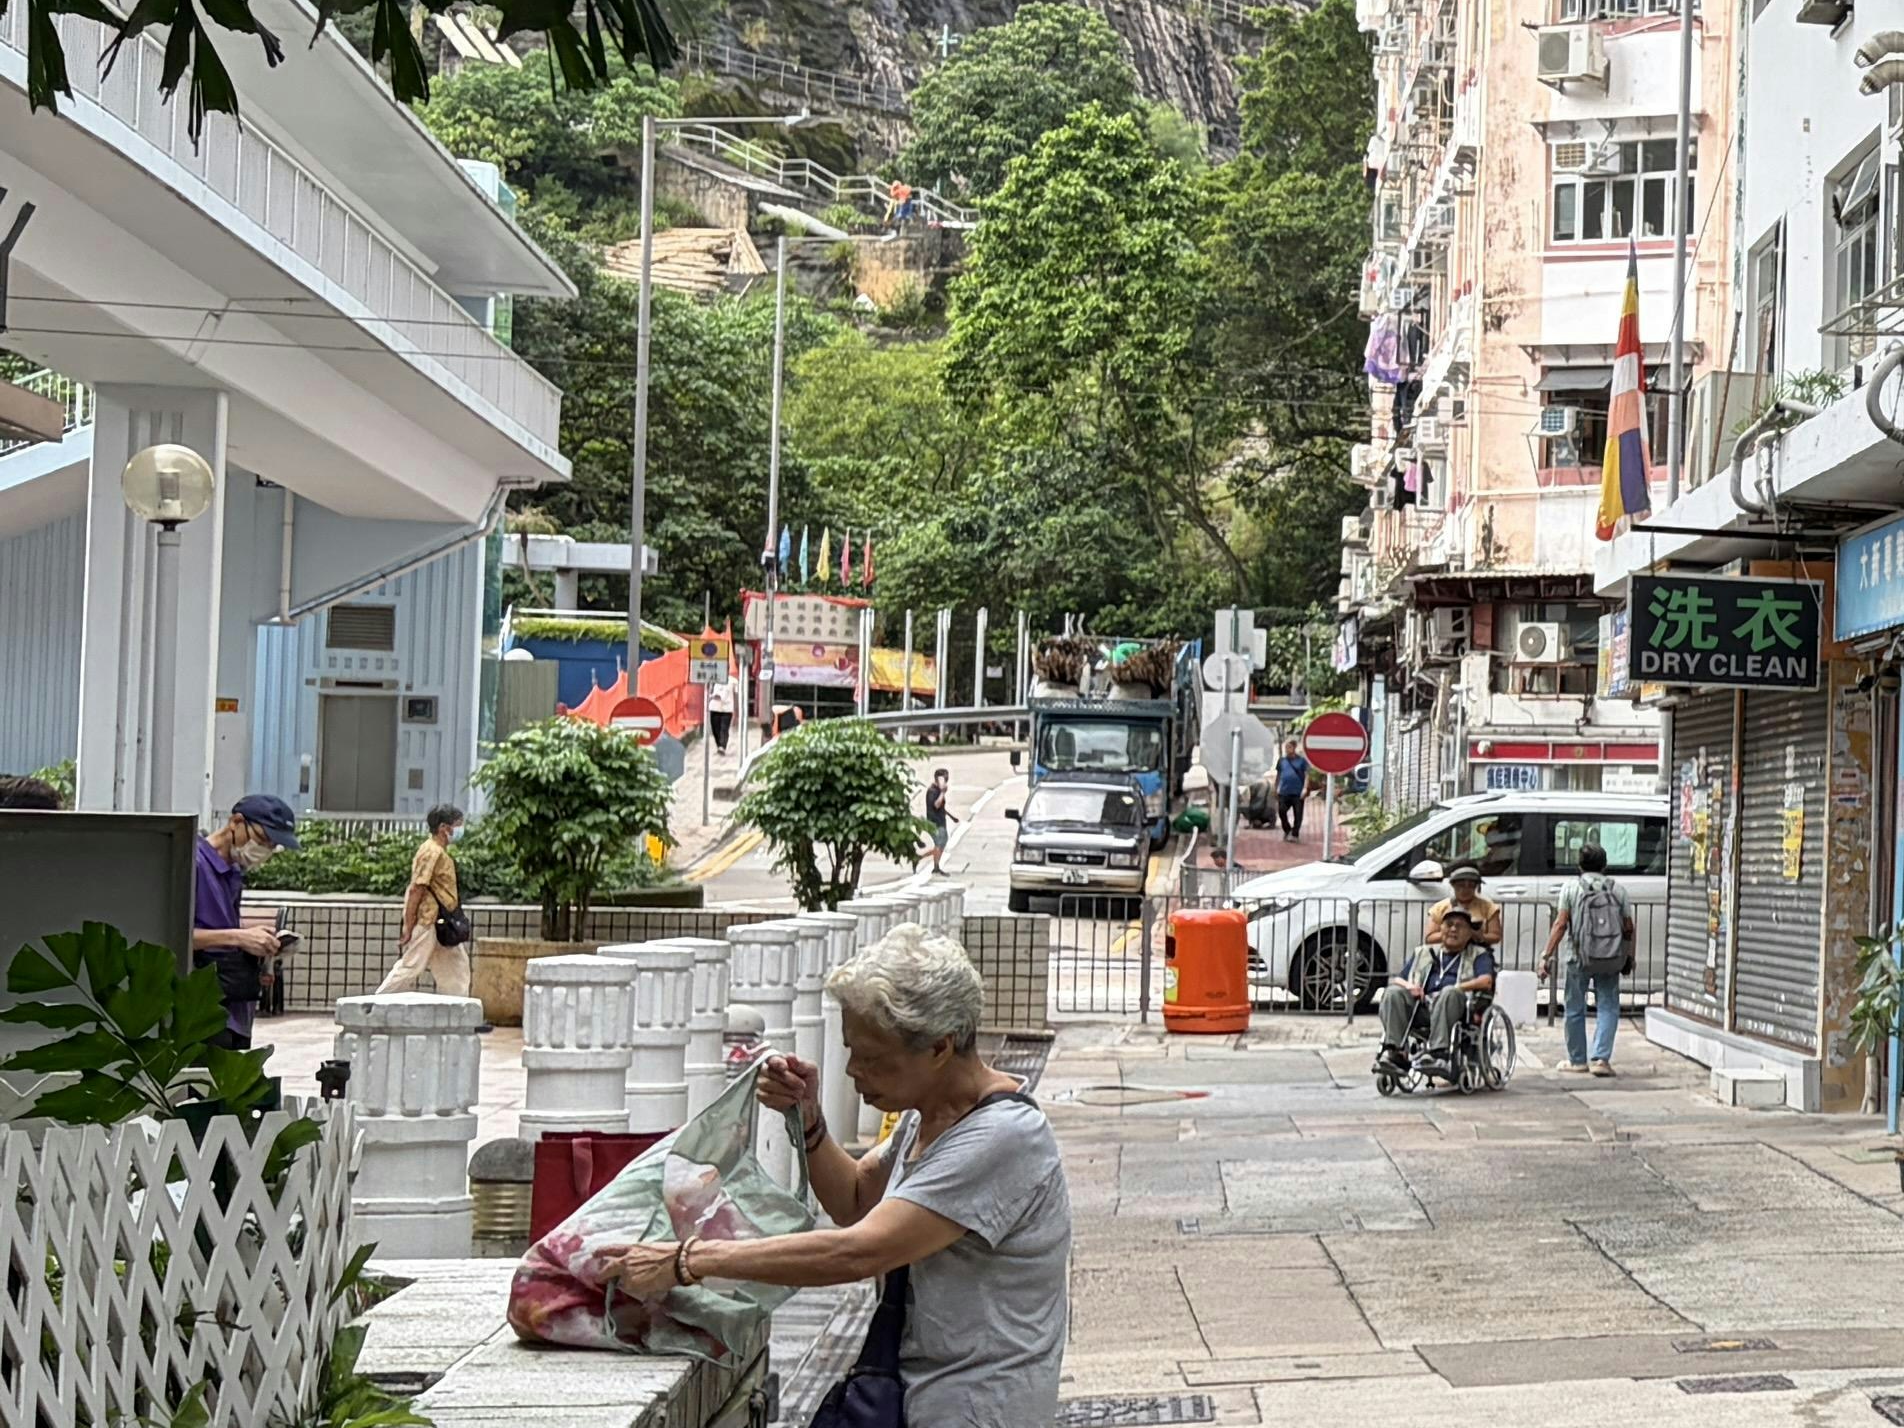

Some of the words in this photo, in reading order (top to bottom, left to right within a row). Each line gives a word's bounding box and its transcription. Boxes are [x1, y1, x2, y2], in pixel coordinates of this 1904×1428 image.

[1648, 585, 1804, 653] 洗衣
[1641, 650, 1702, 675] DRY
[1708, 652, 1808, 679] CLEAN
